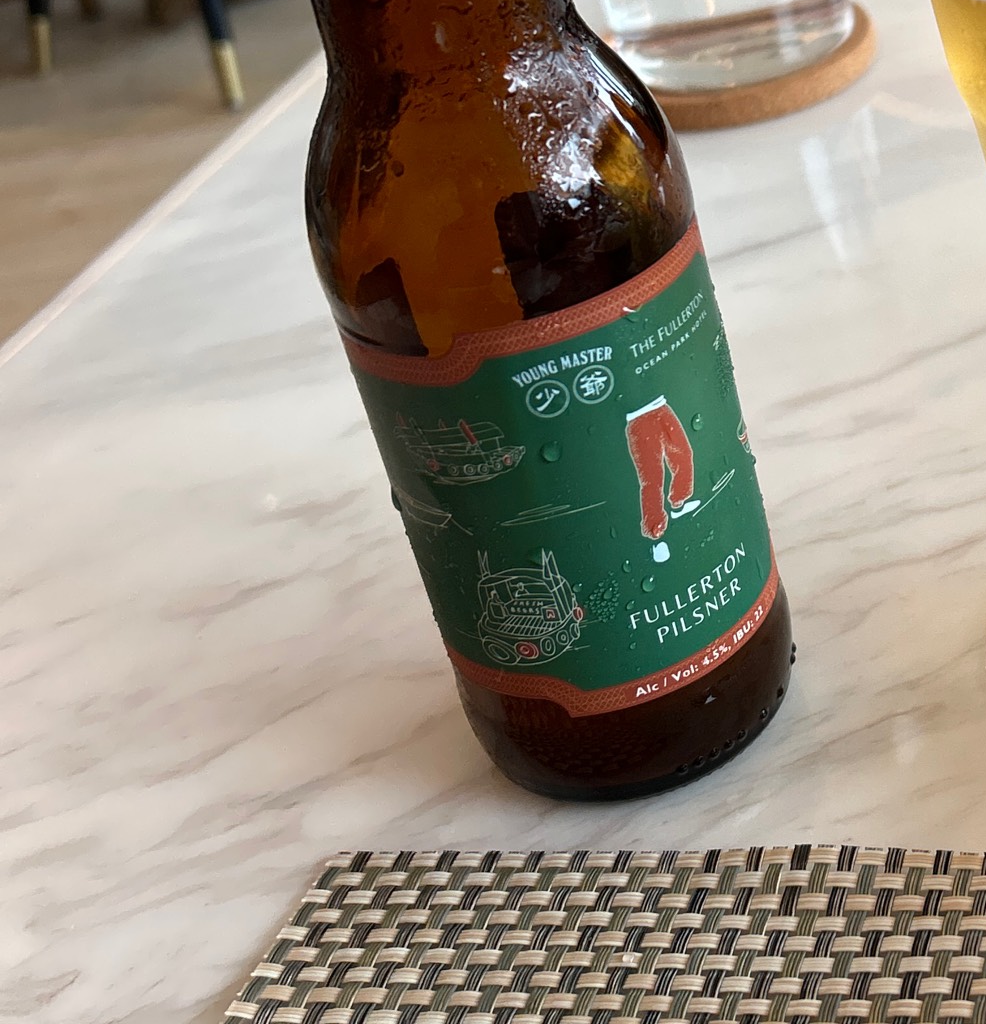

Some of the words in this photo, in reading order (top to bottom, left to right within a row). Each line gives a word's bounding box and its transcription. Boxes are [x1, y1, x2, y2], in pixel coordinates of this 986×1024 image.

[630, 335, 656, 358] THE
[657, 289, 704, 342] FULLERTON
[635, 350, 668, 375] OCEAN
[671, 332, 690, 351] PARK
[511, 360, 558, 388] YOUNG
[560, 346, 613, 370] MASTER
[629, 542, 747, 630] FULLERTON
[656, 578, 742, 643] PILSNER
[636, 681, 659, 697] Alc
[671, 664, 699, 682] Vol:
[733, 620, 754, 643] IBU:
